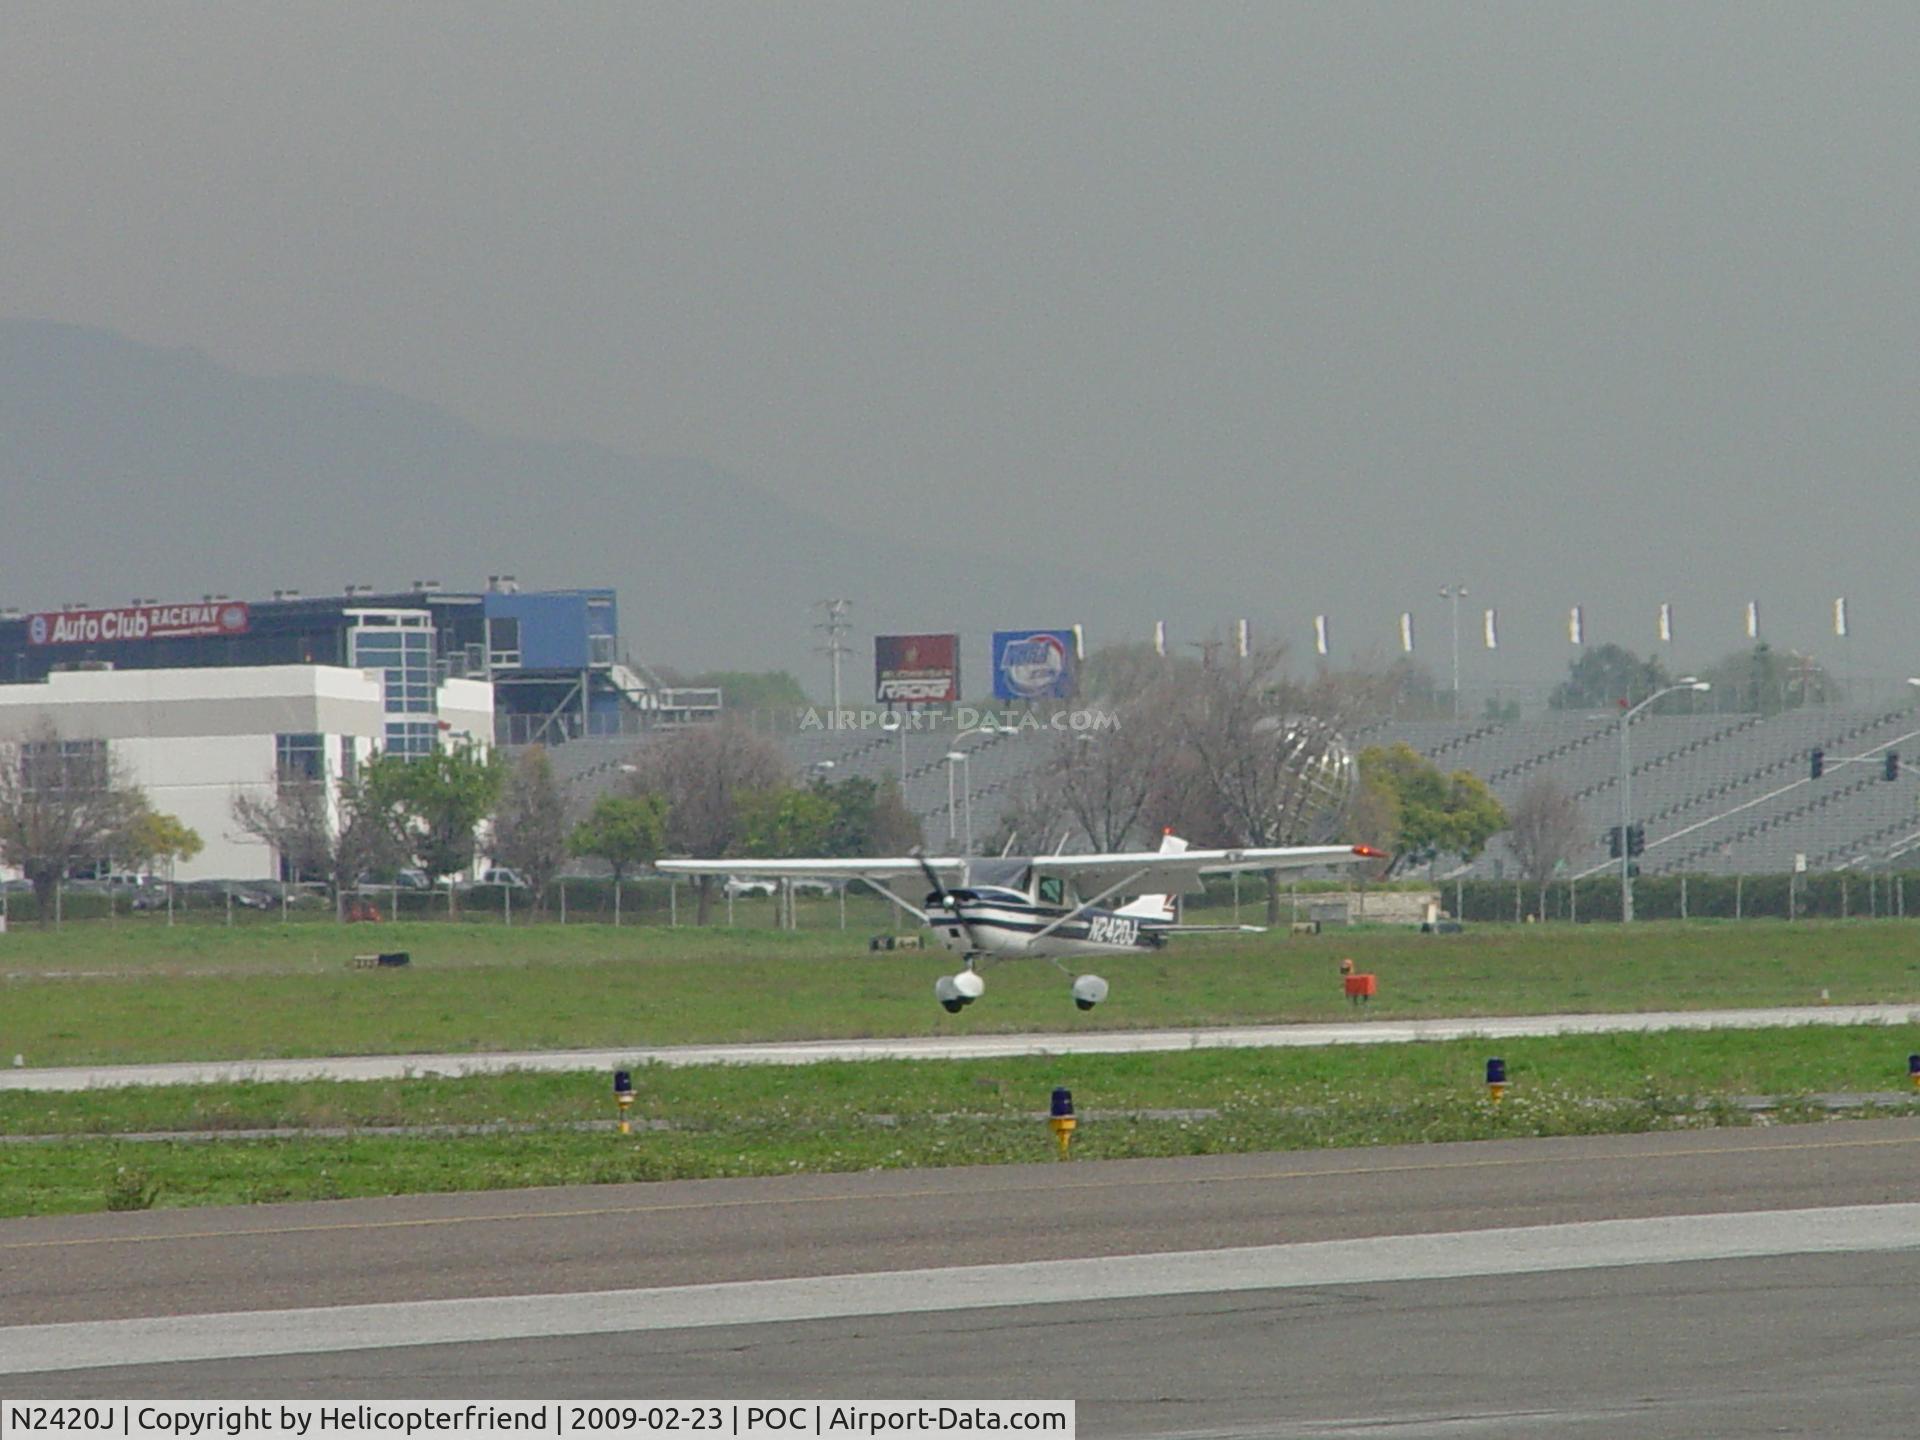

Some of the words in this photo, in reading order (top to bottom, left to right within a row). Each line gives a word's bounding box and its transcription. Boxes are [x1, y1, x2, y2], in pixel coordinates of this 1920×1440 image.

[51, 614, 99, 642] Auto
[101, 609, 149, 639] Club
[151, 606, 219, 626] RACEWAY
[1087, 915, 1141, 946] N2420J
